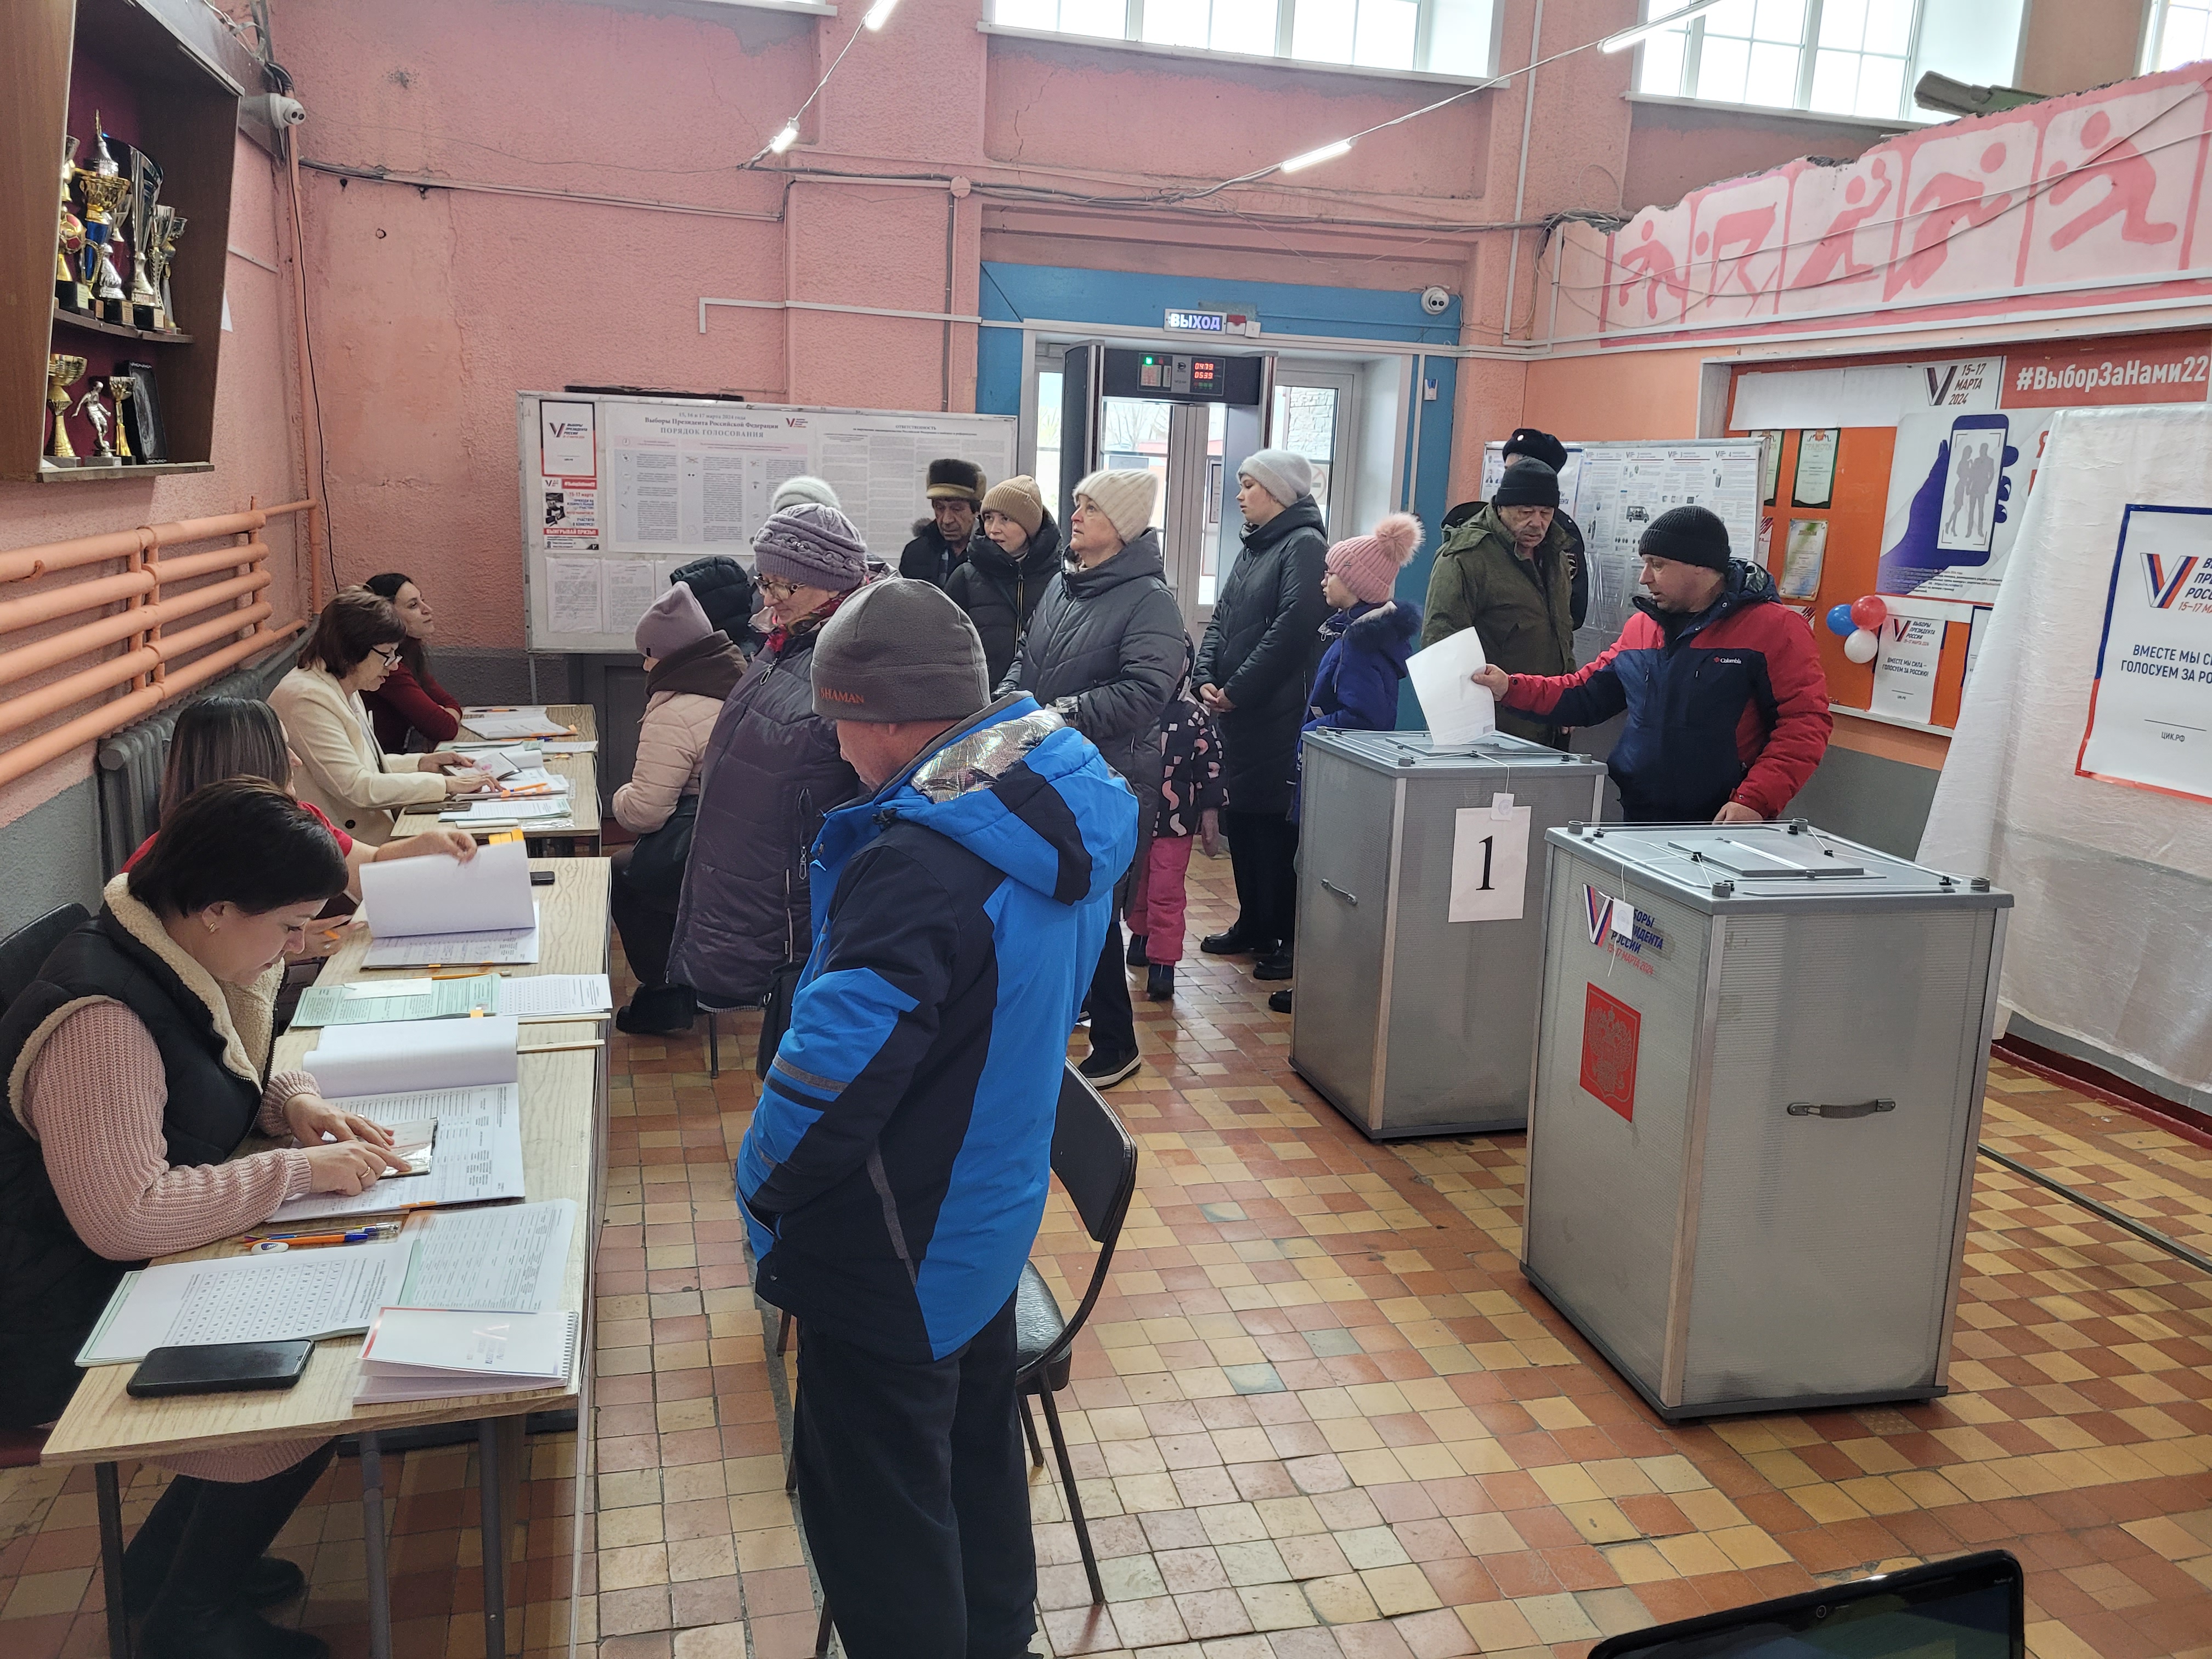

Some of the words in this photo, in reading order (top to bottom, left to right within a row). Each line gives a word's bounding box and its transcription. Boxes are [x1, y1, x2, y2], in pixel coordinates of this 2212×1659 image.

[1170, 313, 1221, 330] ВЫХОД
[1961, 362, 1987, 376] 15-17
[2016, 355, 2209, 393] #ВыборЗаНами22
[1954, 377, 1983, 391] МАРТА
[1948, 393, 1969, 405] 2024
[645, 417, 670, 425] Выборы
[702, 429, 764, 438] ГОЛОСОВАНИЯ
[2178, 601, 2203, 613] 15-17
[1909, 627, 1936, 635] ПРЕЗИДЕНТА
[1887, 657, 1903, 665] ВМЕСТЕ
[2132, 644, 2177, 661] ВМЕСТЕ
[2179, 650, 2200, 664] МЫ
[1882, 664, 1904, 673] ГОЛОСУЕМ
[1909, 669, 1929, 677] РОССИЮ!
[2121, 659, 2179, 679] ГОЛОСУЕМ
[2181, 668, 2195, 682] ЗА
[820, 687, 865, 704] SHAMAN
[2161, 731, 2185, 742] ЦИК.РФ
[1475, 835, 1496, 891] 1
[1621, 951, 1640, 969] МАРТА
[1640, 961, 1654, 975] 2024
